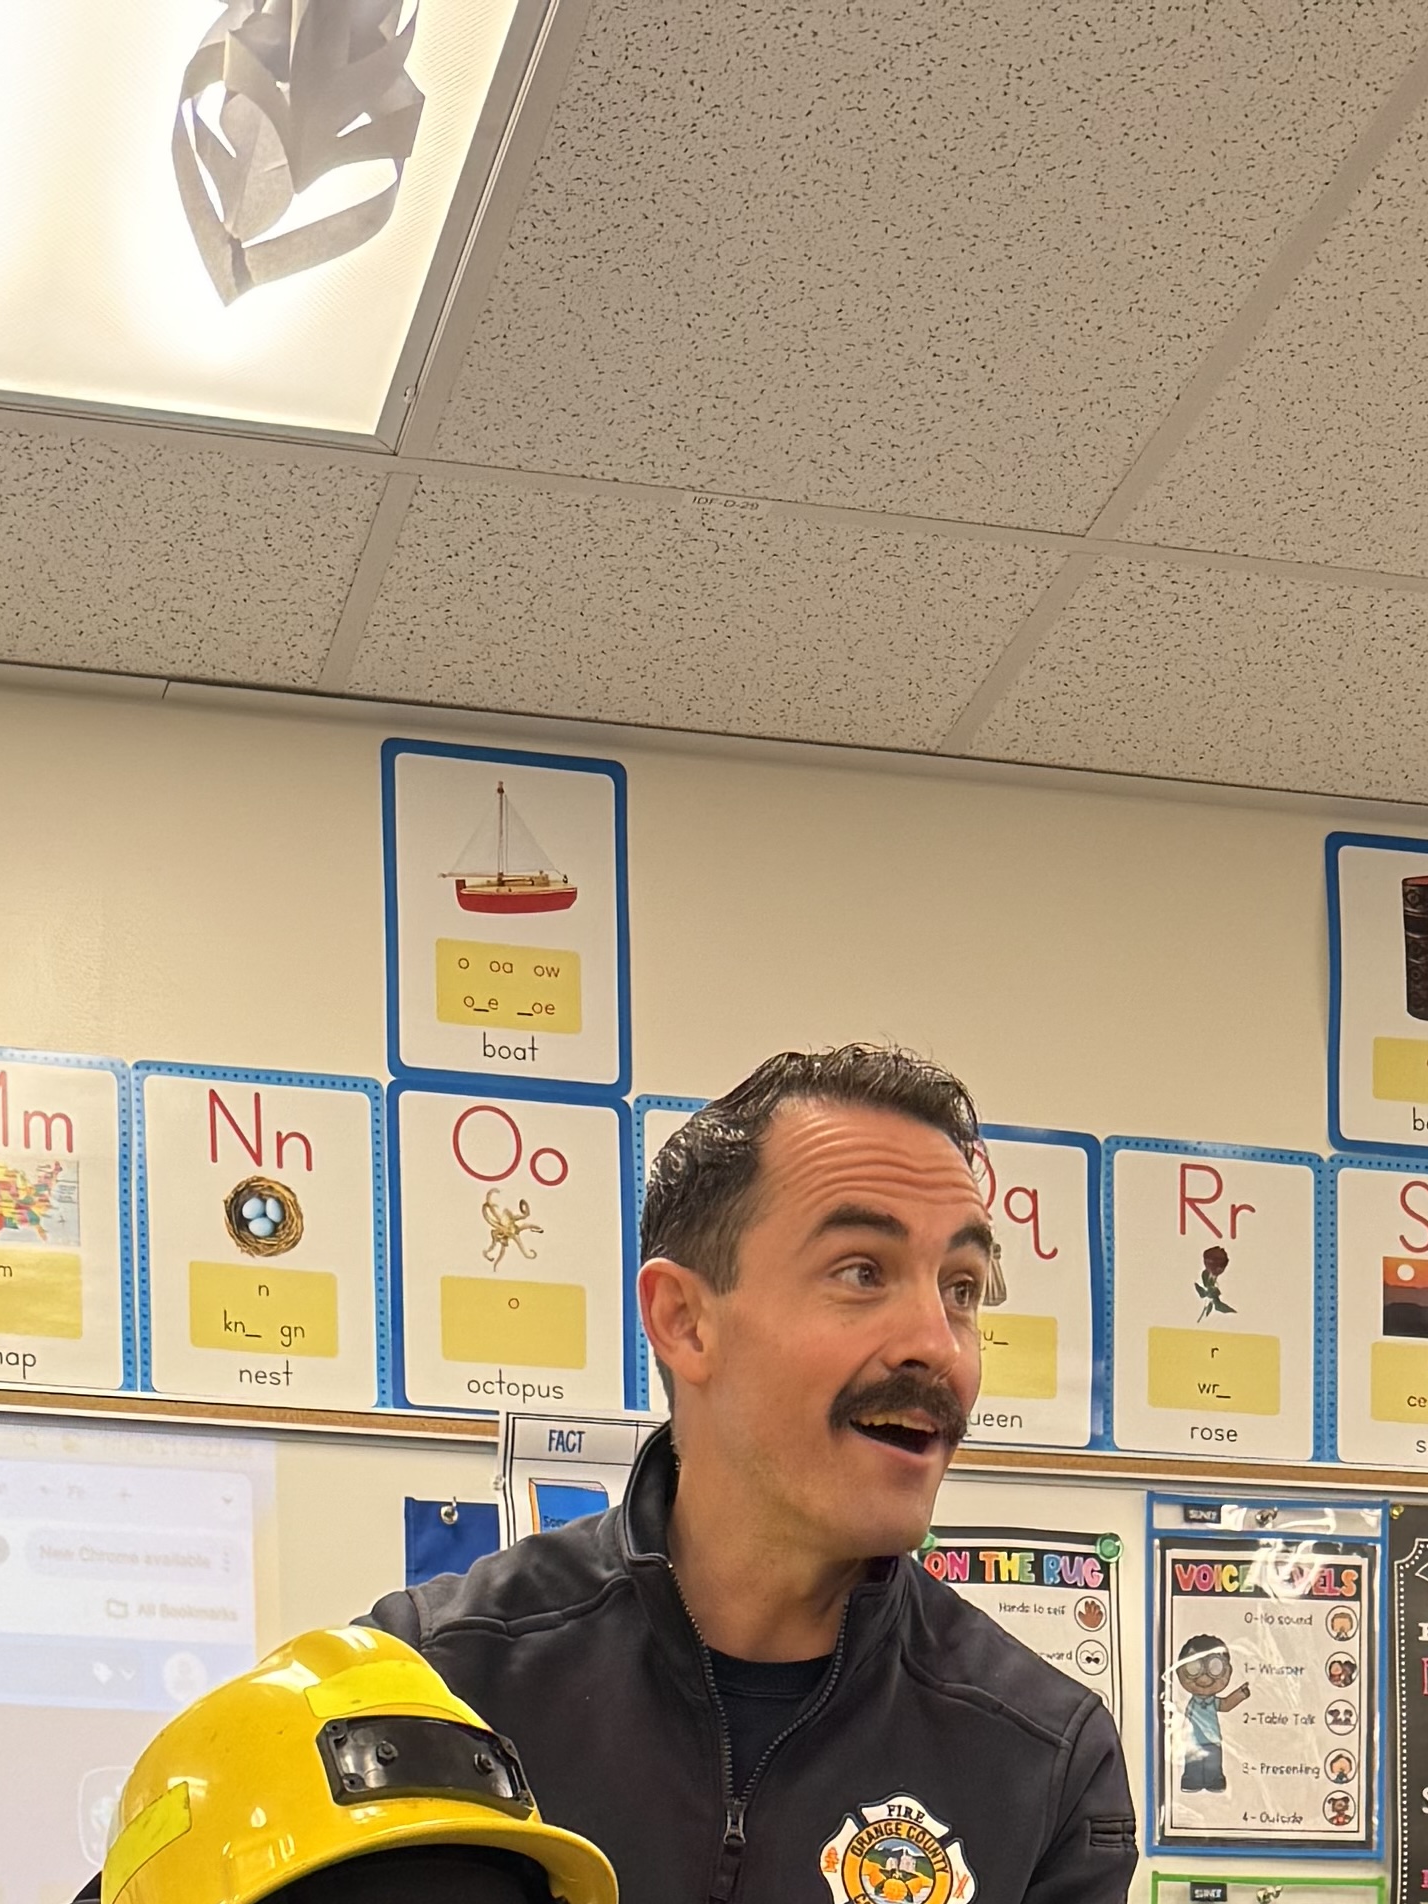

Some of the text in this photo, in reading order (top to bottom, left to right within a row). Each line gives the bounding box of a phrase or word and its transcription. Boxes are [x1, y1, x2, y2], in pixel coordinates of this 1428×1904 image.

[483, 1034, 539, 1062] boat
[209, 1089, 312, 1171] Nn
[453, 1106, 568, 1186] Oo
[1179, 1163, 1256, 1240] Rr
[239, 1362, 293, 1388] nest
[468, 1374, 564, 1401] octopus
[548, 1430, 584, 1453] FACT
[1190, 1426, 1238, 1443] rose
[924, 1551, 1104, 1588] ON THE RUG
[887, 1804, 925, 1823] FIRE
[850, 1822, 950, 1874] ORANGE COUNTY
